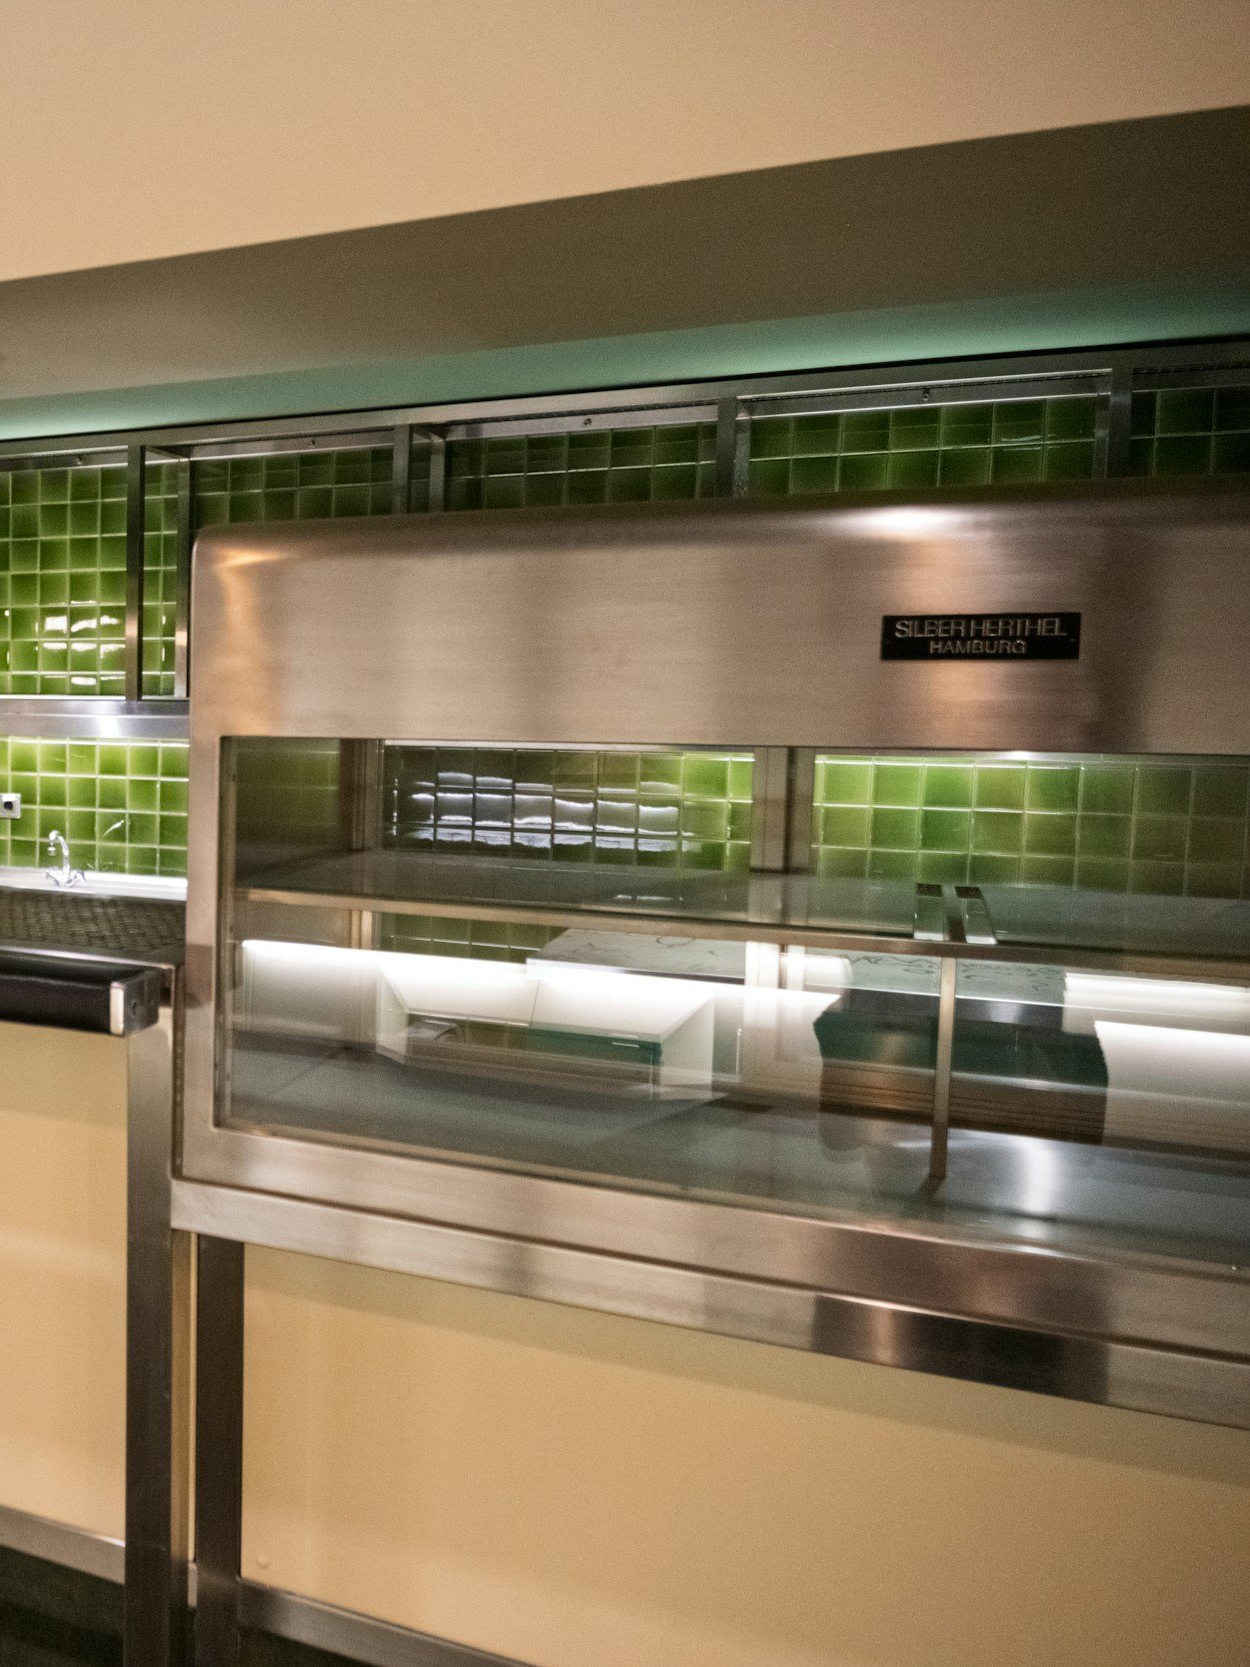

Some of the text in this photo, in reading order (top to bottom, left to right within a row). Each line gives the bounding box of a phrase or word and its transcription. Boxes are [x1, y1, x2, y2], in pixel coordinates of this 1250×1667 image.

[895, 618, 1067, 638] SILBER HERTHEL
[930, 640, 1026, 654] HAMBURG
